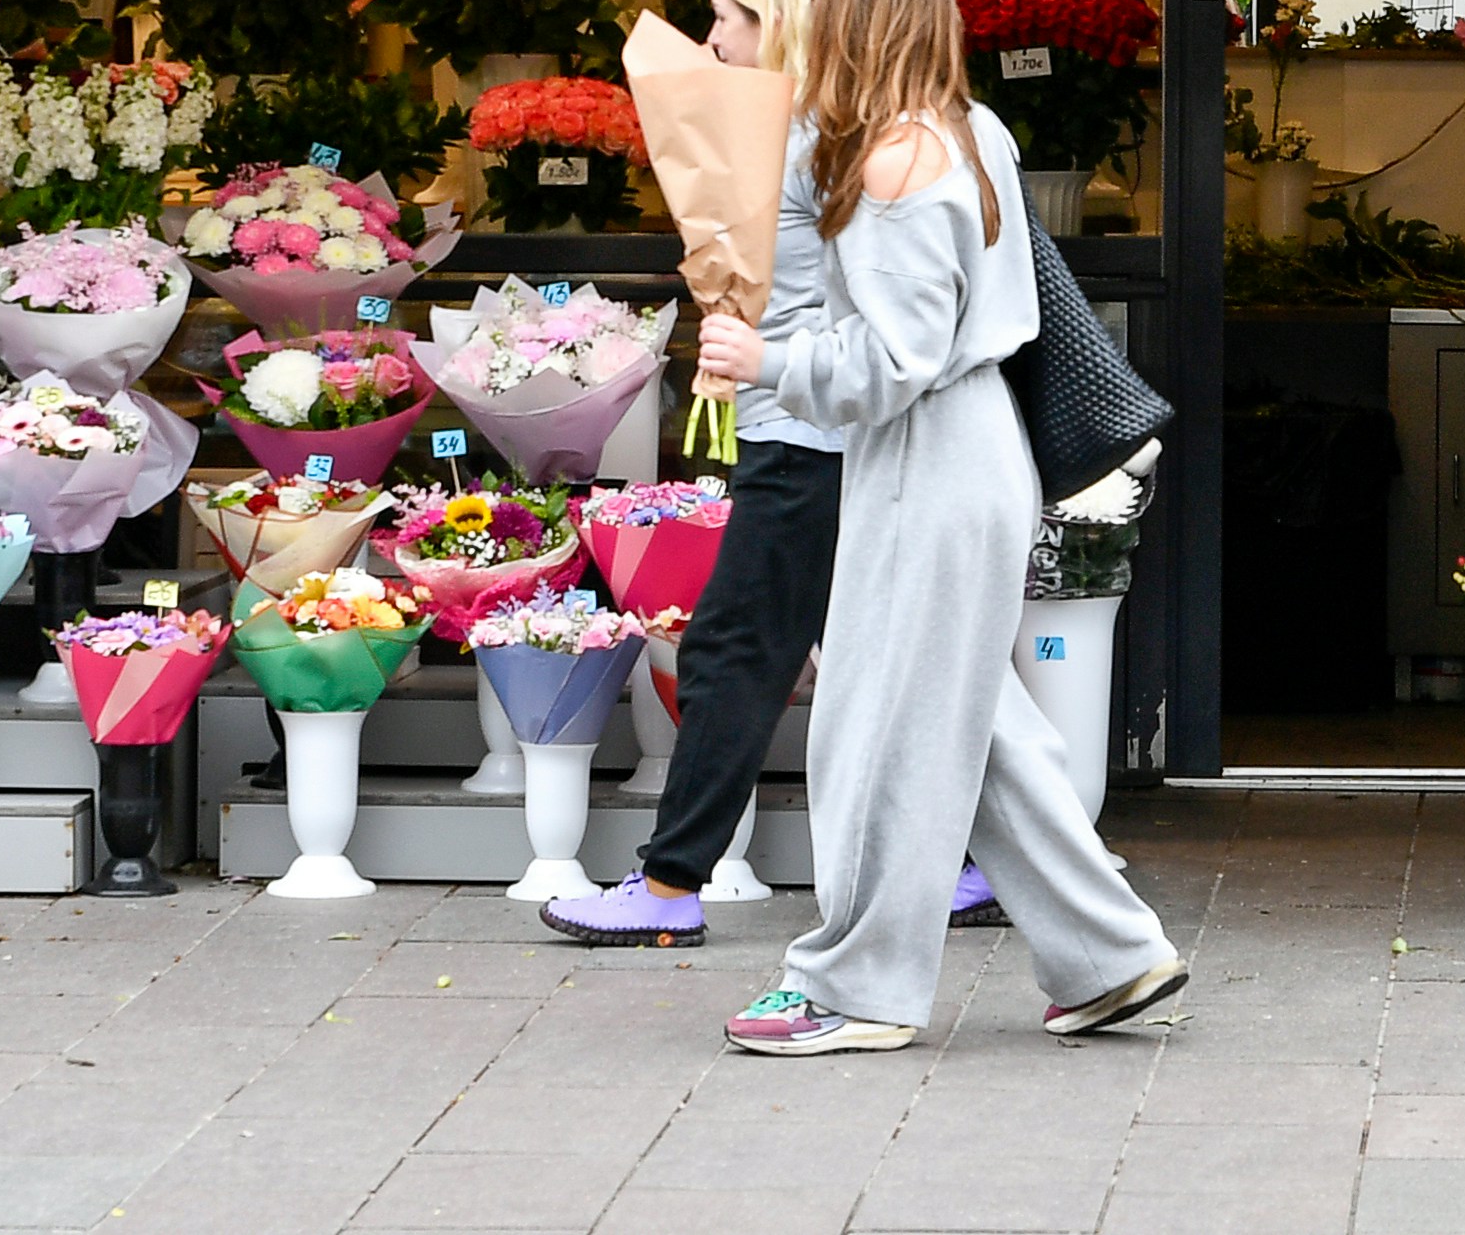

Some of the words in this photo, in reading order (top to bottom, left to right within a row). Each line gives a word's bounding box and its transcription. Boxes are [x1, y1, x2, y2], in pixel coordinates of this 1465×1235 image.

[1012, 59, 1043, 71] 1.70€
[361, 298, 389, 317] 30
[437, 436, 459, 453] 34
[1040, 637, 1055, 660] 4
